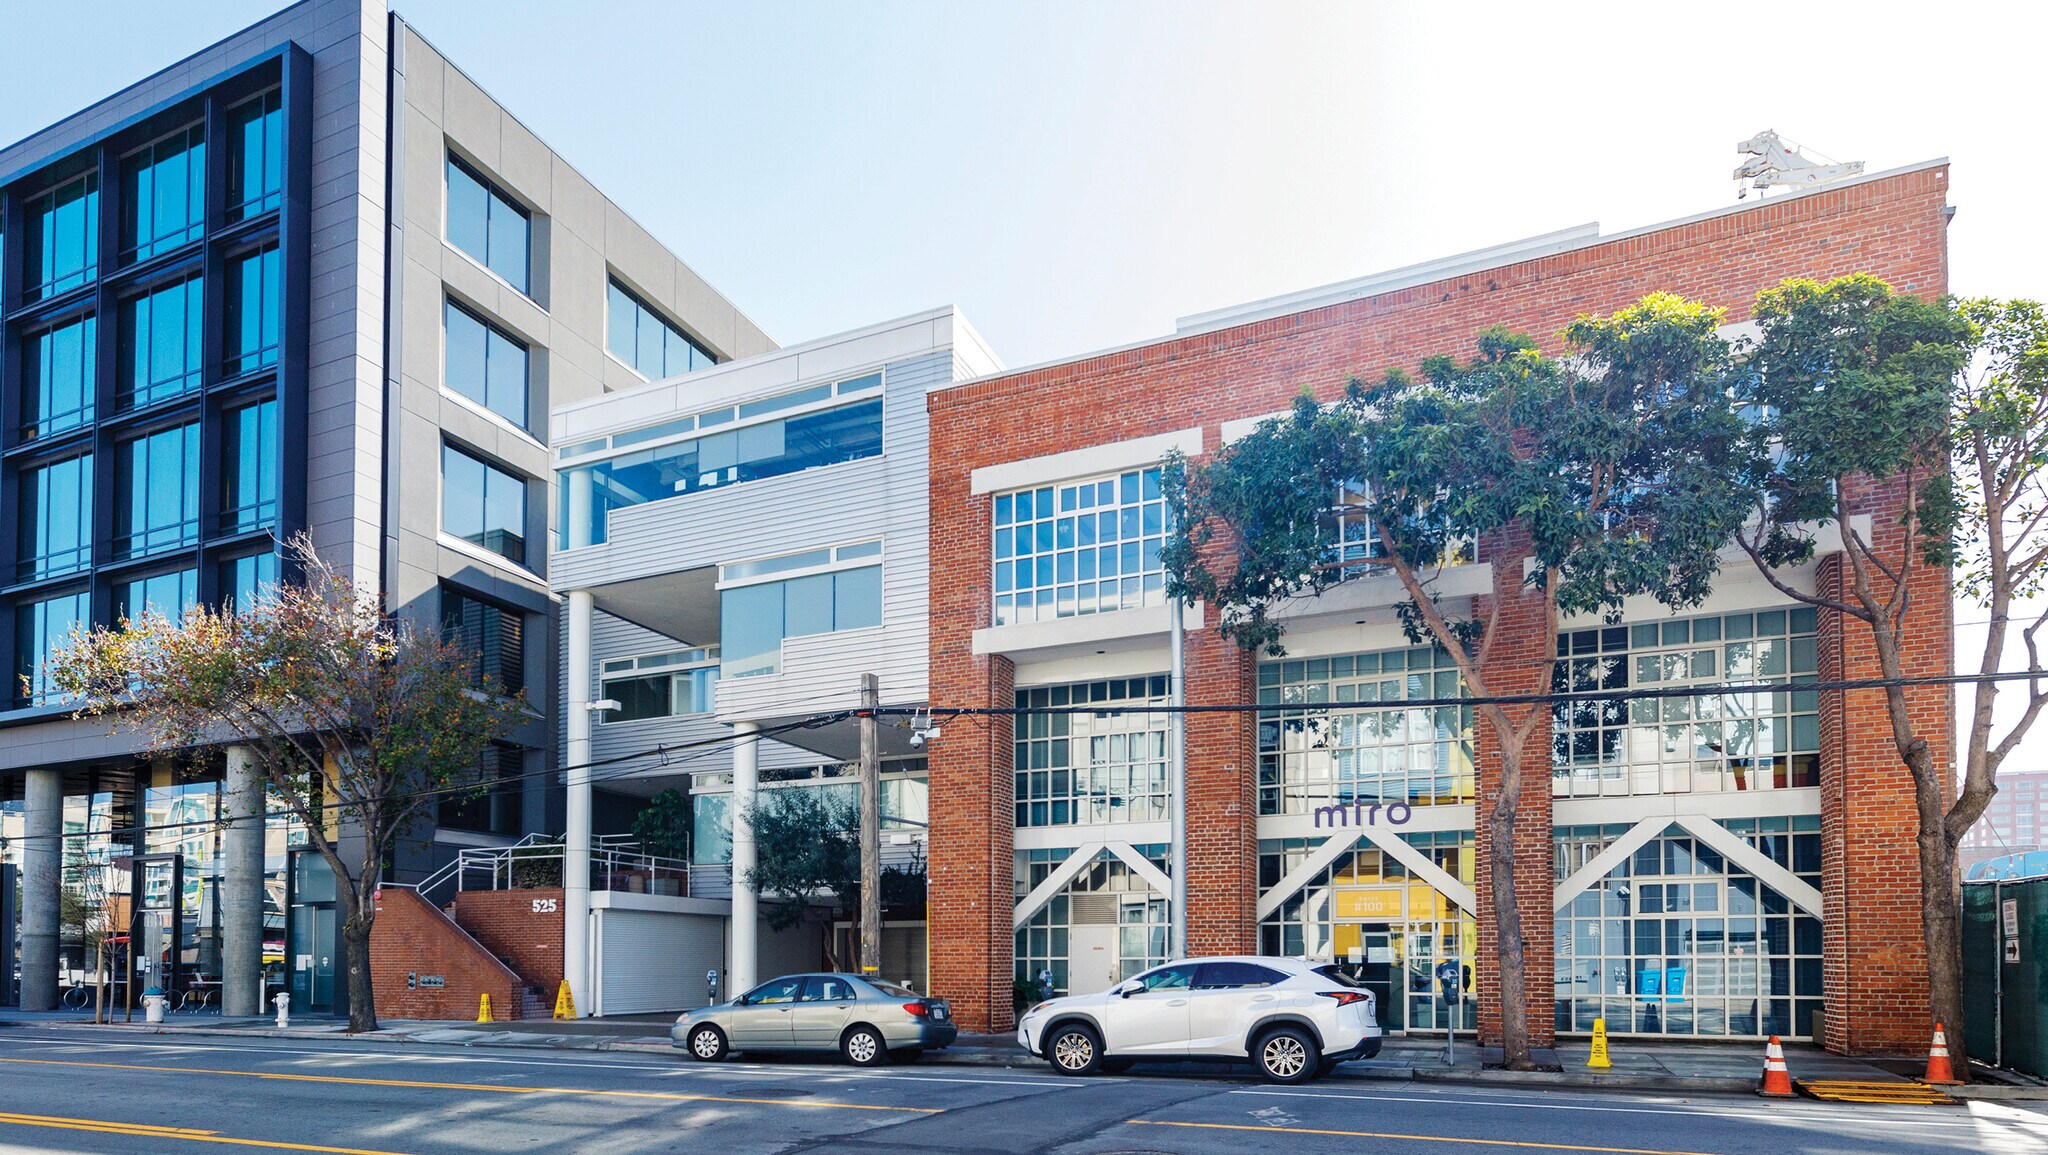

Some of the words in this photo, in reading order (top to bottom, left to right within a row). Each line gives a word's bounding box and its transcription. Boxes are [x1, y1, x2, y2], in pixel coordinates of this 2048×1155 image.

[1315, 798, 1411, 828] miro
[532, 898, 557, 913] 525
[1354, 901, 1383, 912] #100
